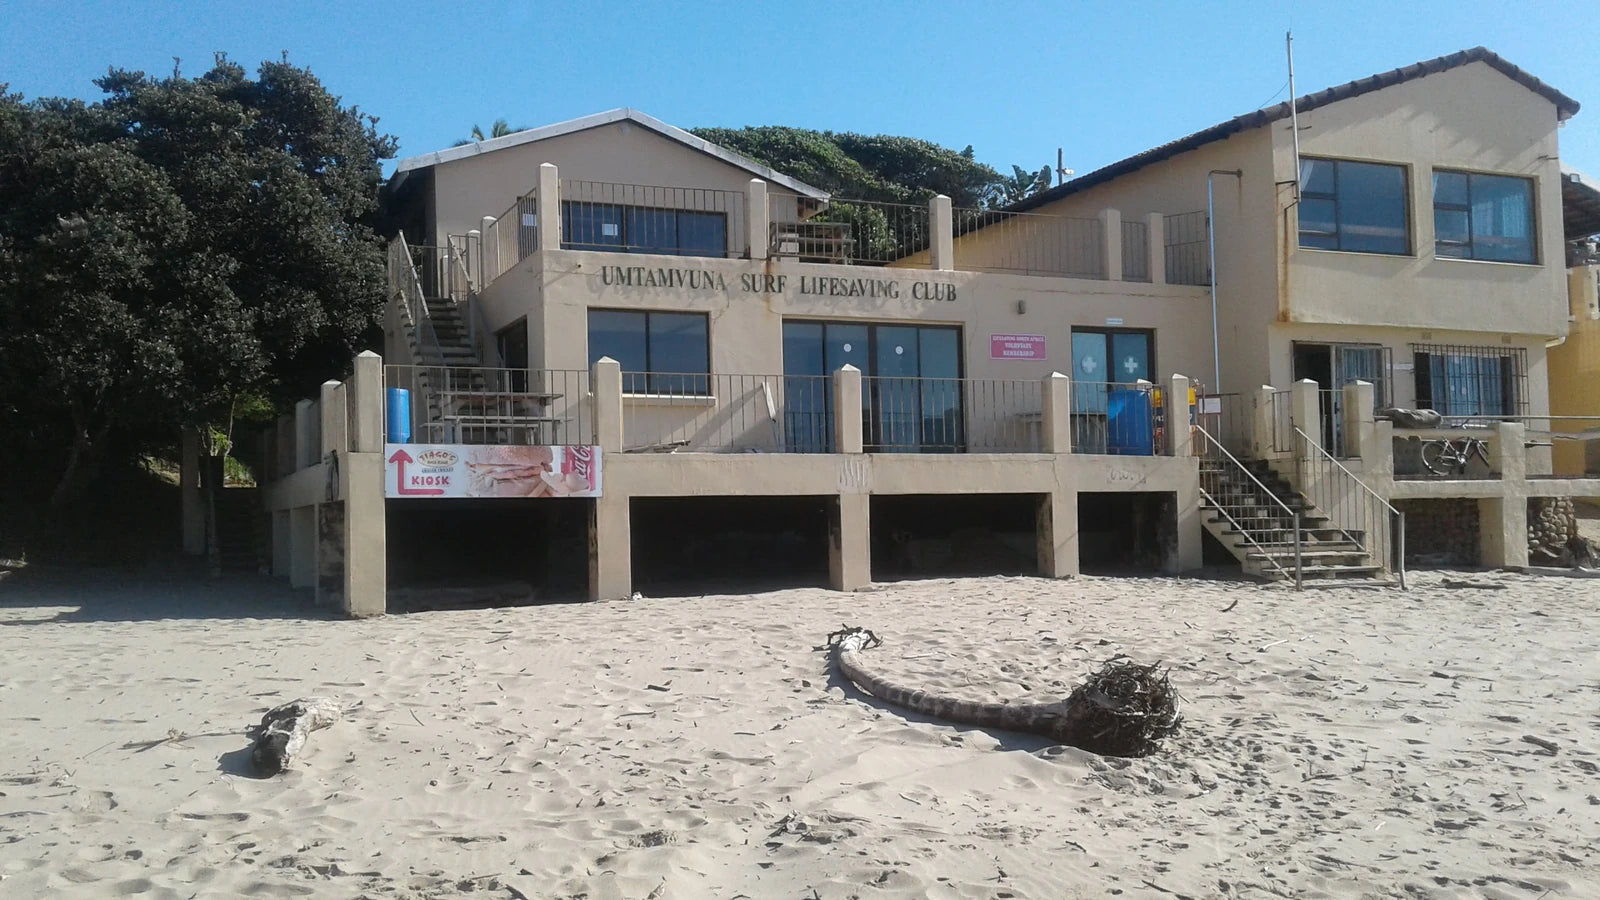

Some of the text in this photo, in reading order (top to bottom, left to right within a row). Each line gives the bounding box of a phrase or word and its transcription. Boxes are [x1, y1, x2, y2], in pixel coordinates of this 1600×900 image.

[601, 265, 957, 302] UMTAMVUNA SURF LIFESAVING CLUB
[411, 475, 450, 486] KIOSK
